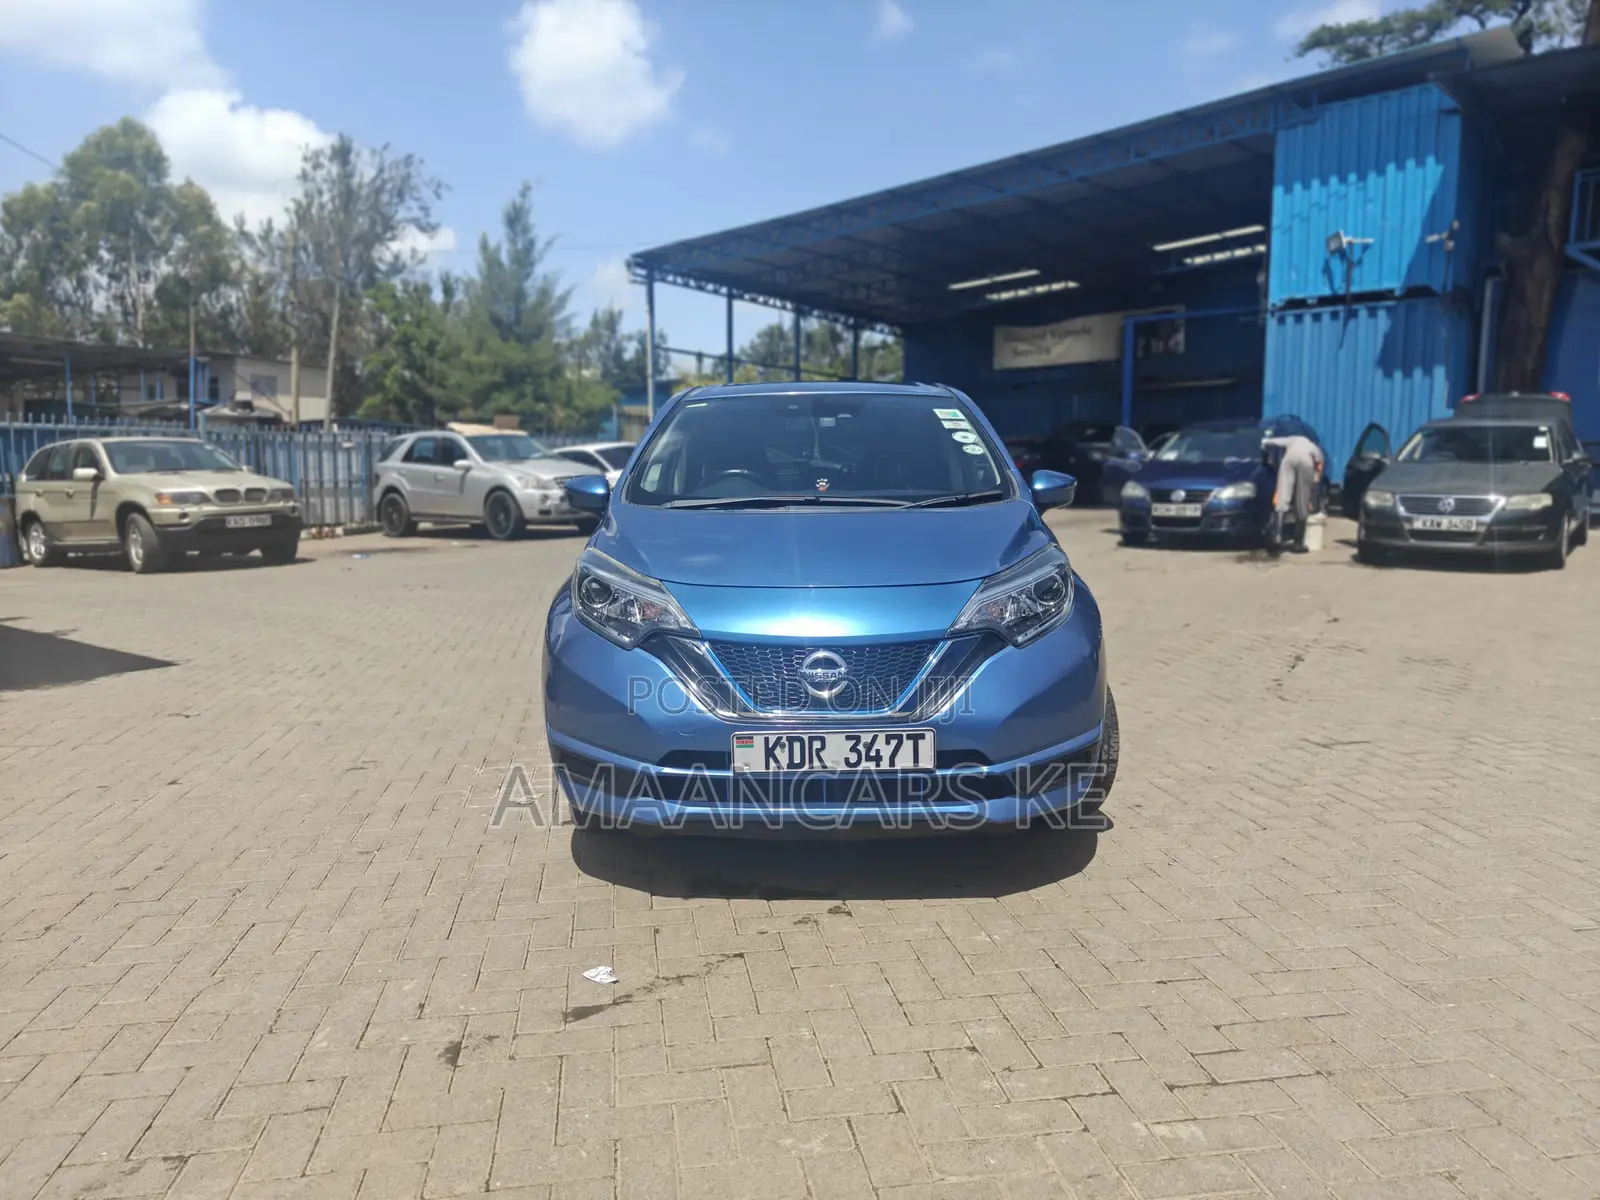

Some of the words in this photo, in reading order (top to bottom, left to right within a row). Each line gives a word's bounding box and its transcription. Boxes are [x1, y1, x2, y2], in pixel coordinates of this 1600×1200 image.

[802, 671, 847, 681] NISSAN
[763, 735, 829, 771] KDR
[843, 732, 926, 769] 347T
